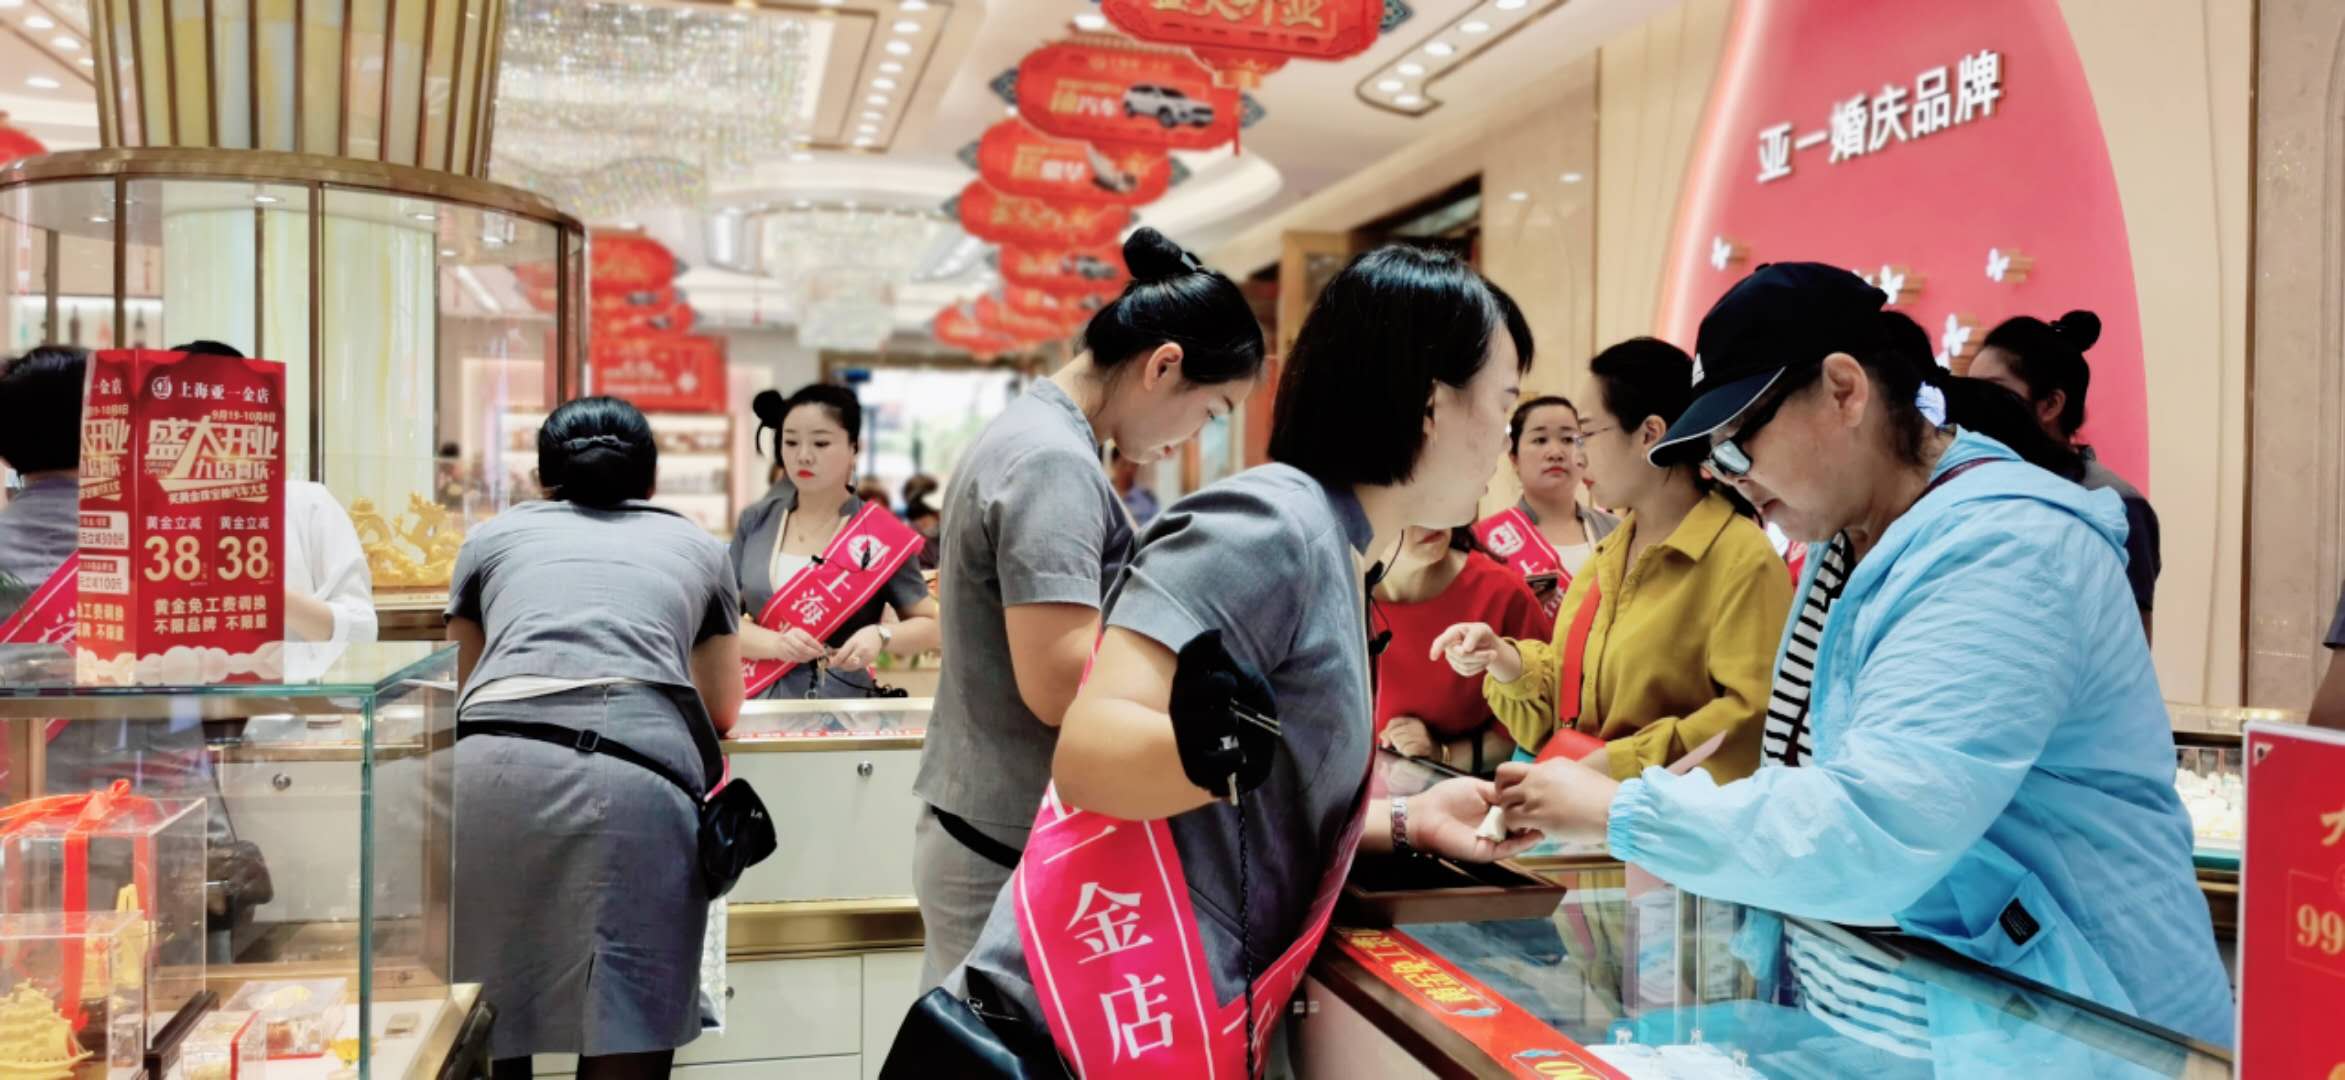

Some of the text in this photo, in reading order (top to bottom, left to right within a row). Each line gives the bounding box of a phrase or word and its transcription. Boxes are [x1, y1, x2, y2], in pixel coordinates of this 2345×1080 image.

[1757, 50, 2003, 183] 亚一婚庆品牌
[180, 380, 270, 404] 上海亚一金店
[144, 415, 279, 478] 盛大开业
[146, 515, 202, 531] 黄金立减
[220, 515, 270, 531] 黄金立减
[143, 535, 200, 582] 38
[217, 535, 270, 581] 38
[153, 594, 267, 617] 黄金免工费调换
[153, 613, 268, 635] 不限品牌 不限量
